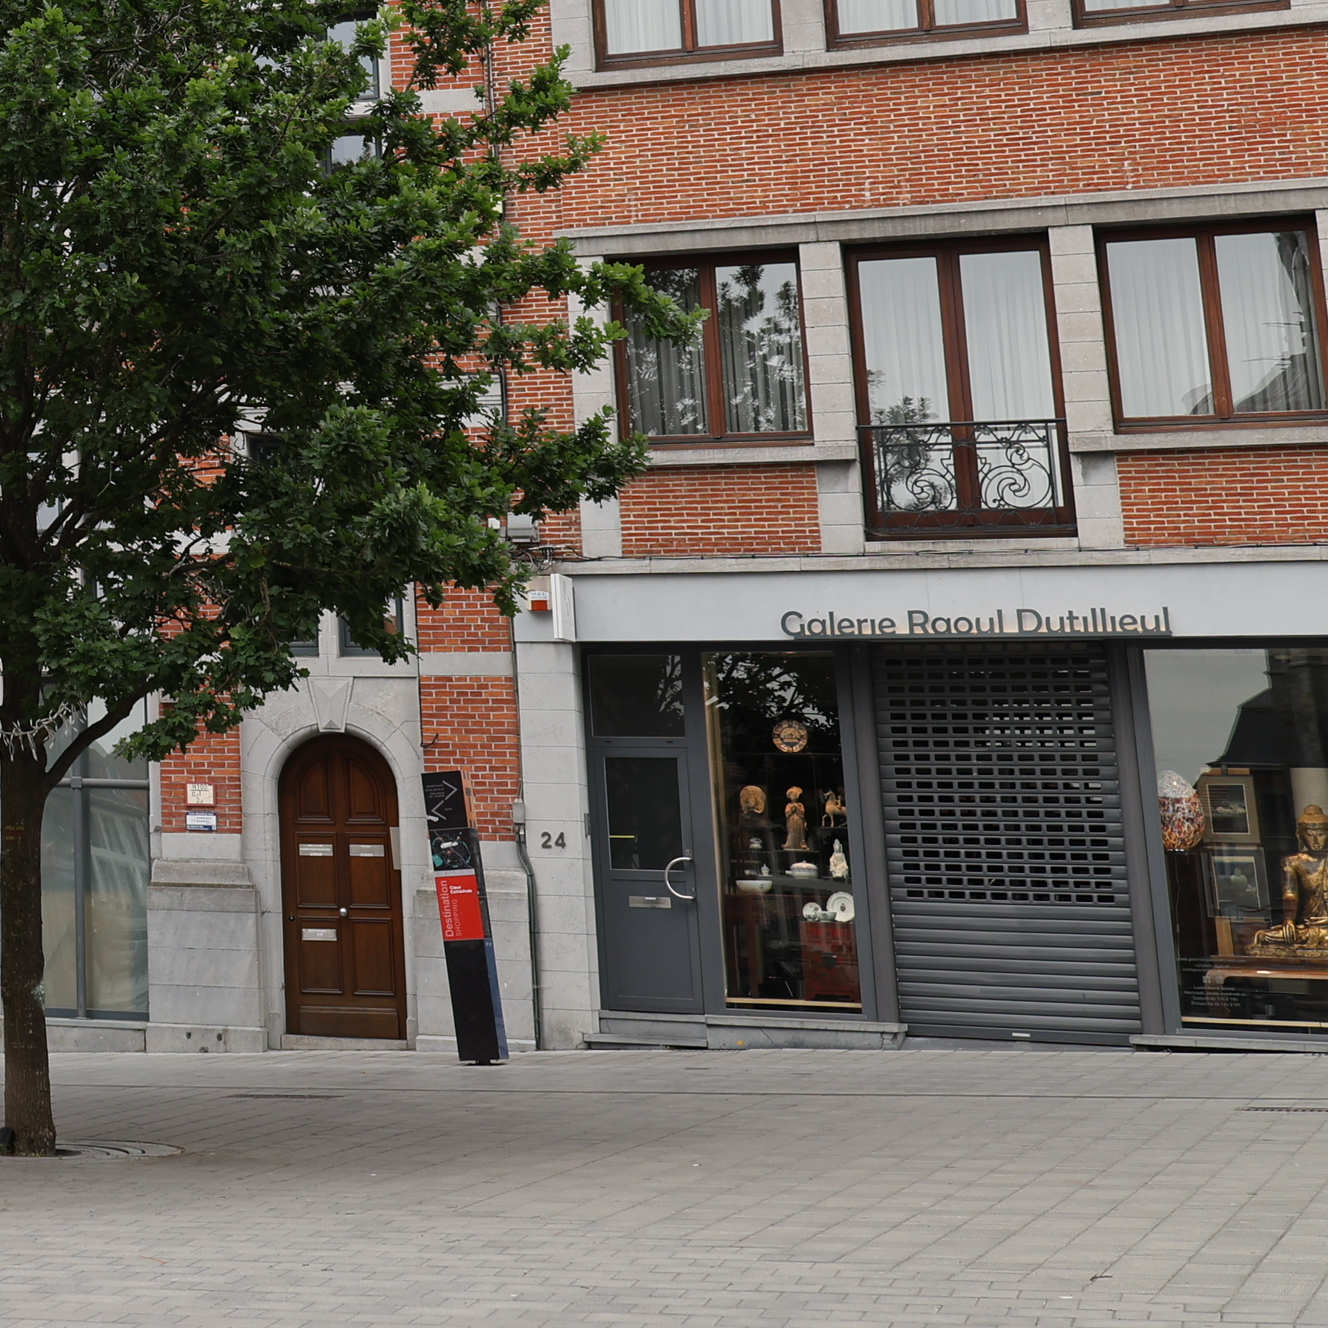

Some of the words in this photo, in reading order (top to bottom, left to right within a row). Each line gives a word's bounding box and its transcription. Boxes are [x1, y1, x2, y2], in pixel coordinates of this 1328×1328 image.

[780, 610, 897, 637] Galerie
[907, 609, 1003, 635] Raoul
[1016, 606, 1173, 634] Dutillieul
[541, 831, 566, 849] 24
[440, 880, 454, 937] Destination
